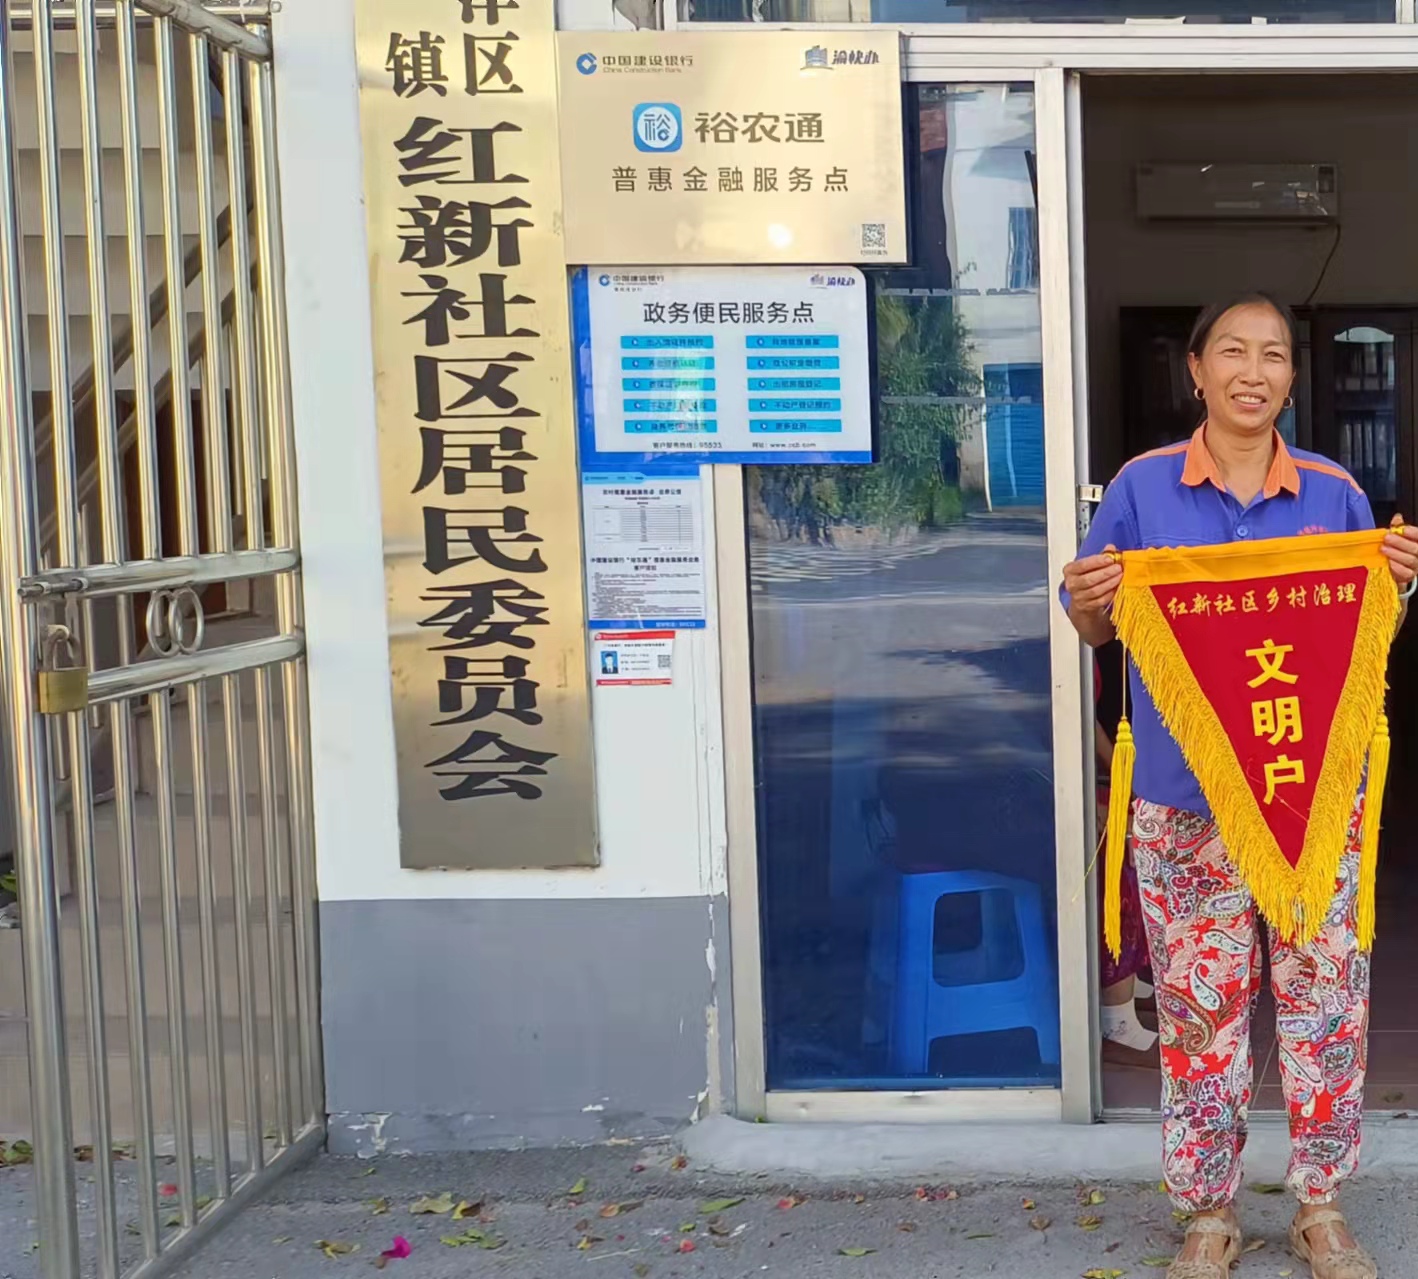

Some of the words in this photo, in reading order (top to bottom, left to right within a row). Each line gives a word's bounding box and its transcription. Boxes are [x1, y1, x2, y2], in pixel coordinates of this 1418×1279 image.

[385, 31, 449, 98] 镇
[602, 55, 693, 67] 中国建设银行
[694, 112, 825, 143] 裕农通
[612, 166, 849, 192] 普惠金融服务点
[643, 302, 814, 324] 政务便民服务点
[393, 117, 559, 801] 红新社区居民委员会
[1167, 583, 1357, 619] 红新社区乡村治理
[1245, 639, 1306, 805] 文明户
